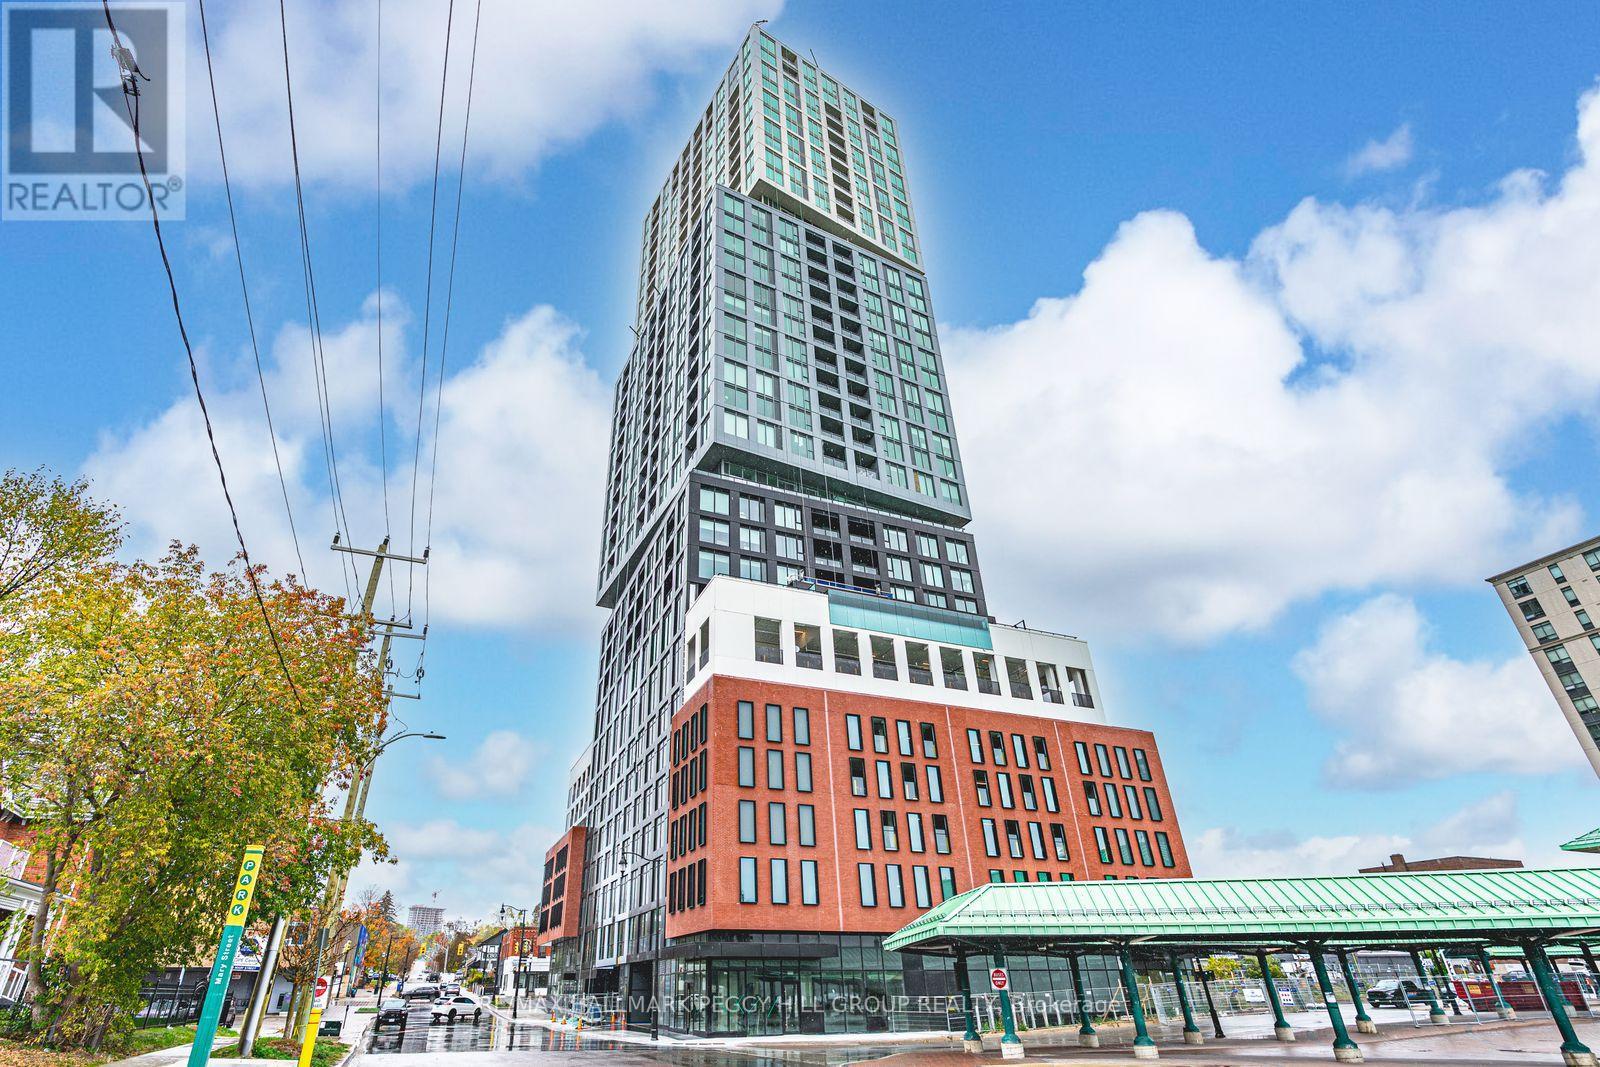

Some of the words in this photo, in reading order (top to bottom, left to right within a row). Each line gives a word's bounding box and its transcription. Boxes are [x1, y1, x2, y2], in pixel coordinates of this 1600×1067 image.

[232, 860, 255, 915] PARK
[214, 963, 227, 985] Mary
[221, 934, 234, 961] Street
